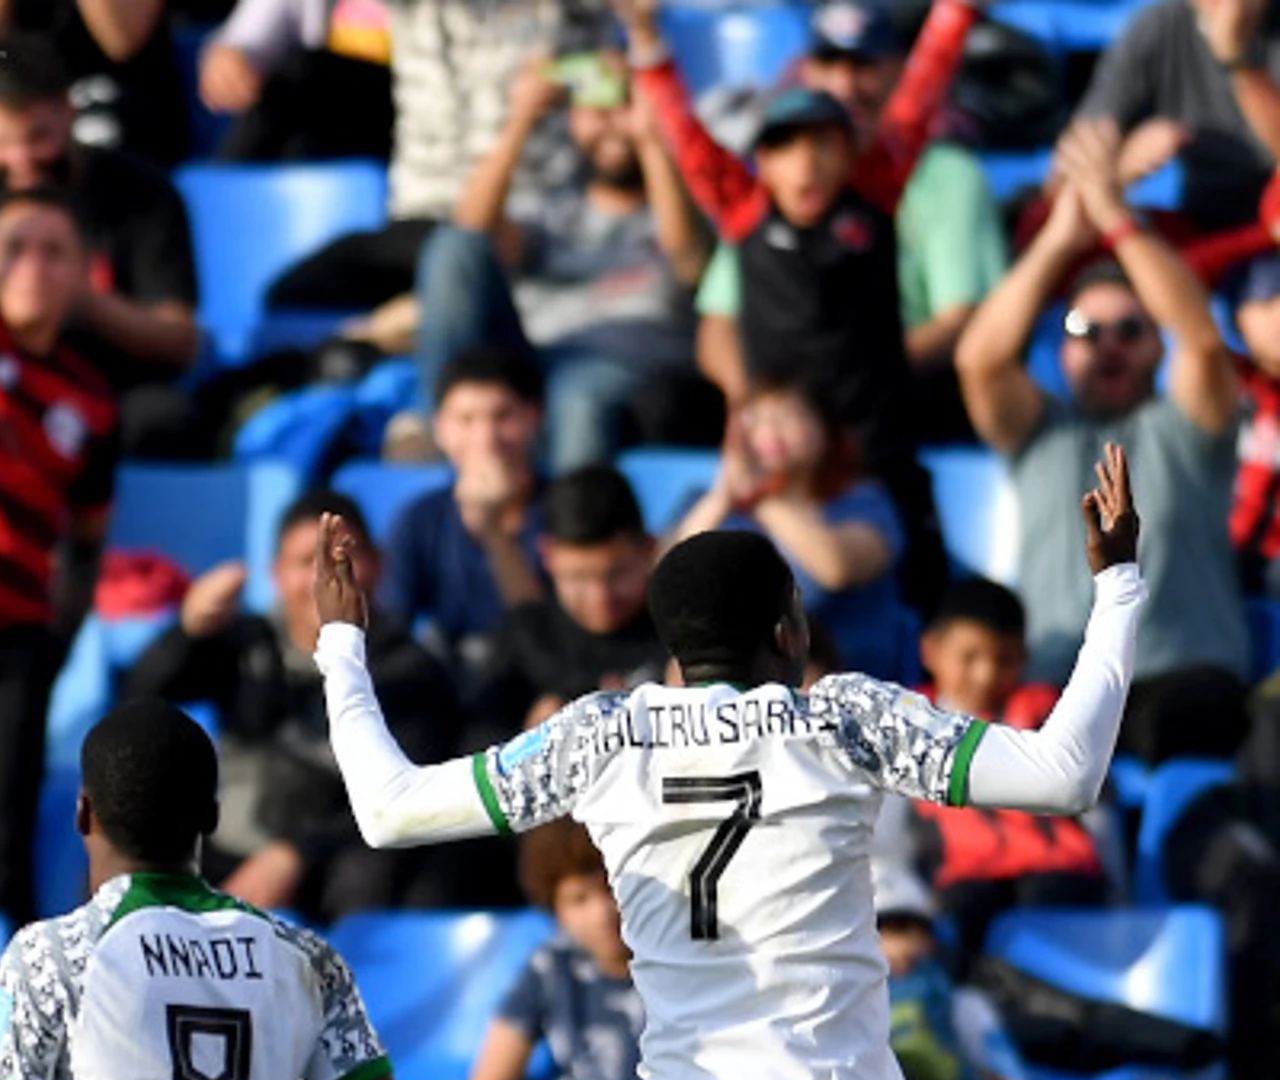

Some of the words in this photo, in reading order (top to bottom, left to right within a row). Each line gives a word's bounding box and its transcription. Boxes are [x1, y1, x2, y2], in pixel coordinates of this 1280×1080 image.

[590, 703, 711, 755] ALIRU
[662, 770, 763, 941] 7
[140, 933, 264, 980] NNADI
